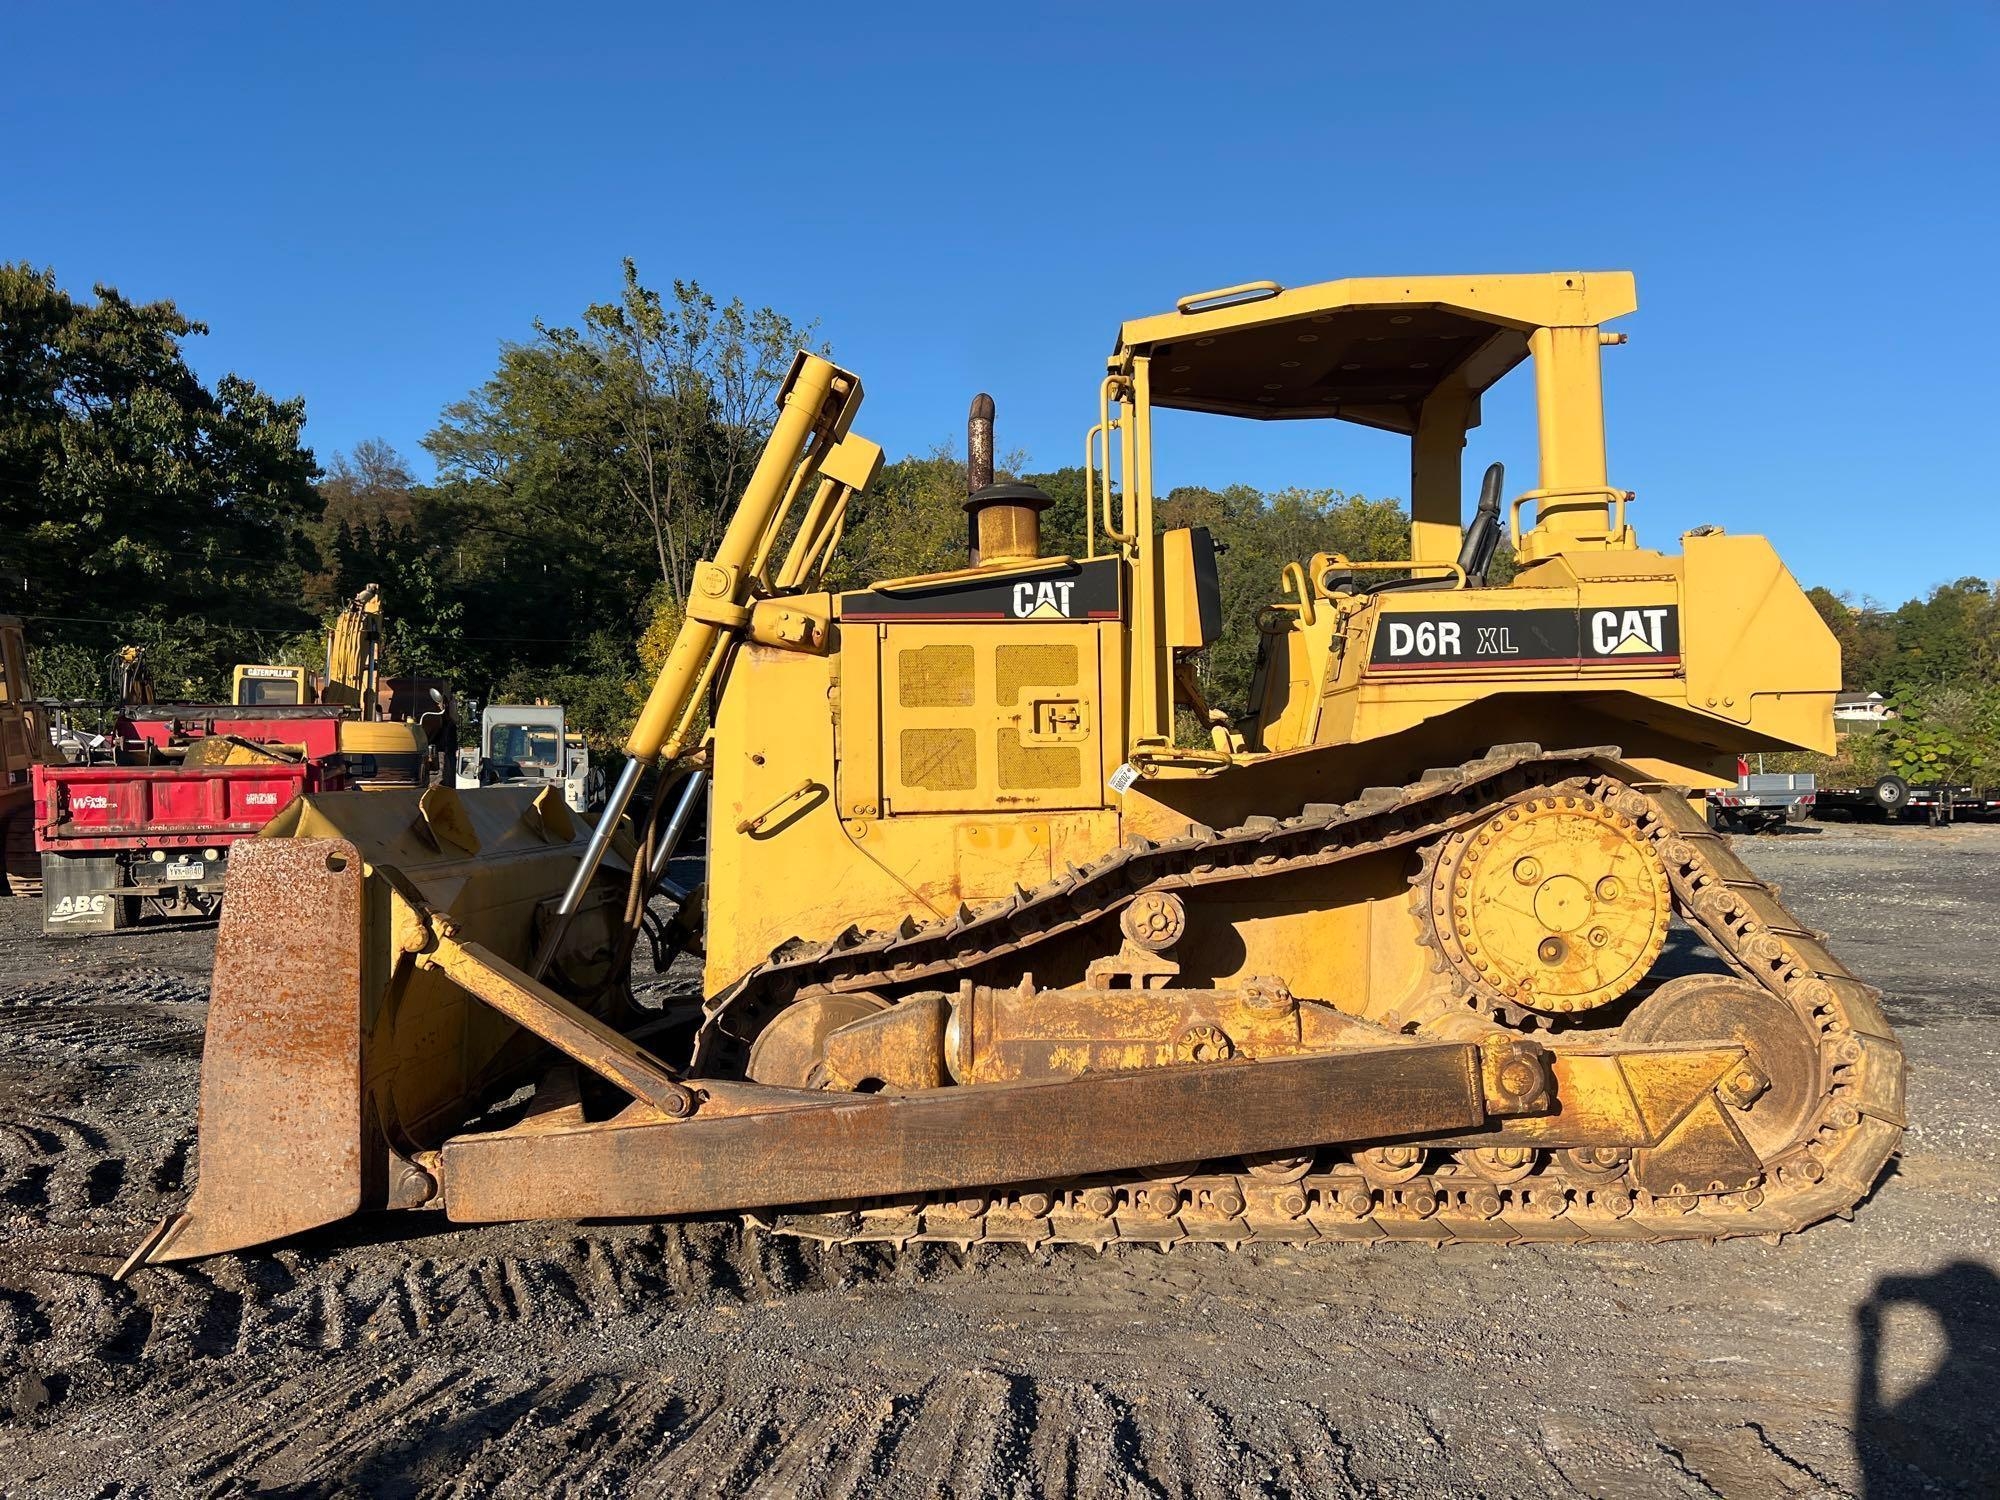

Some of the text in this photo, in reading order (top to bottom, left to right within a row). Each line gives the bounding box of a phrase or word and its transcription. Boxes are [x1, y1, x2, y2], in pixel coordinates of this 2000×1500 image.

[1013, 581, 1075, 618] CAT
[1389, 621, 1519, 657] D6R XL
[1592, 609, 1668, 655] CAT
[247, 668, 293, 677] CATERPILLAR
[56, 895, 105, 912] ABC
